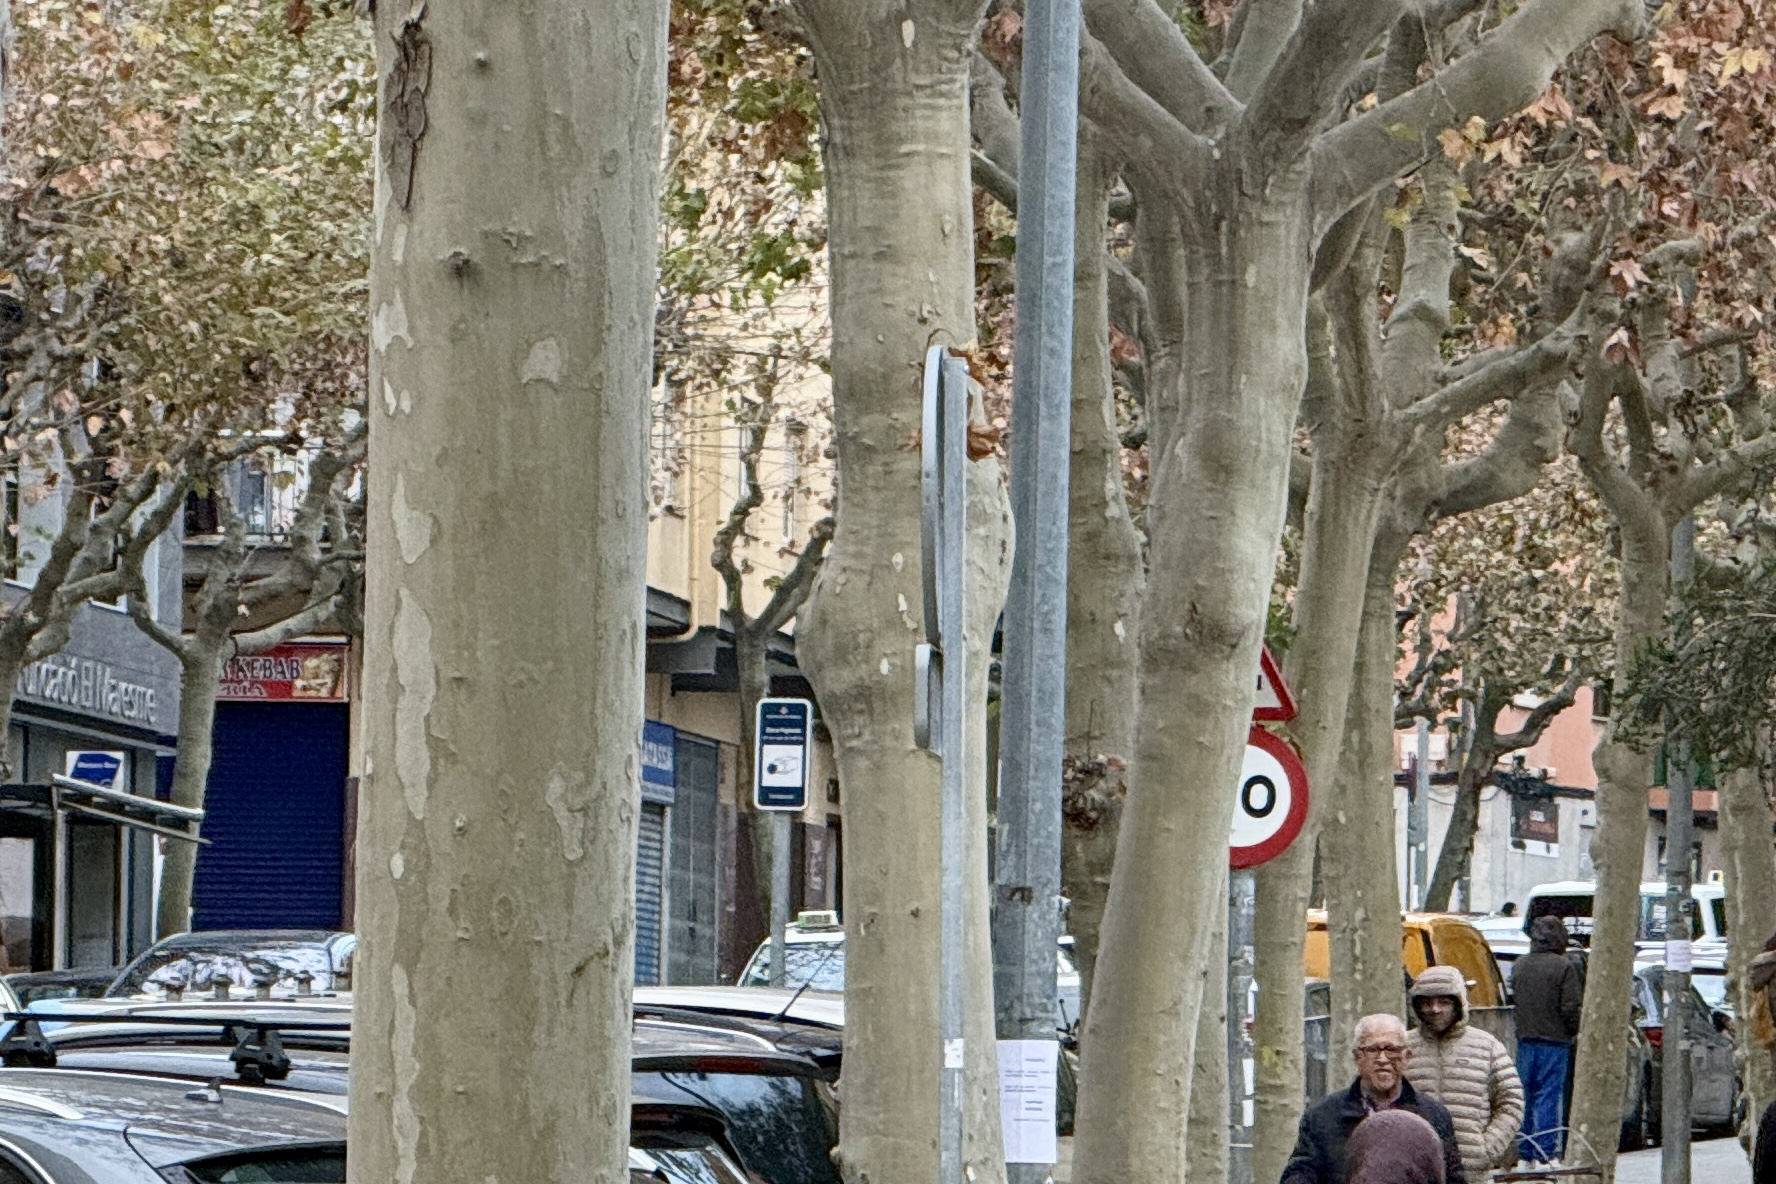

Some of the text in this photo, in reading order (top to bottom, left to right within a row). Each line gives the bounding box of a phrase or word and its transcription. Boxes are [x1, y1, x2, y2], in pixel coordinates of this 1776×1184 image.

[17, 656, 79, 705] undació
[237, 657, 303, 680] KEBAB
[1241, 774, 1276, 819] 0
